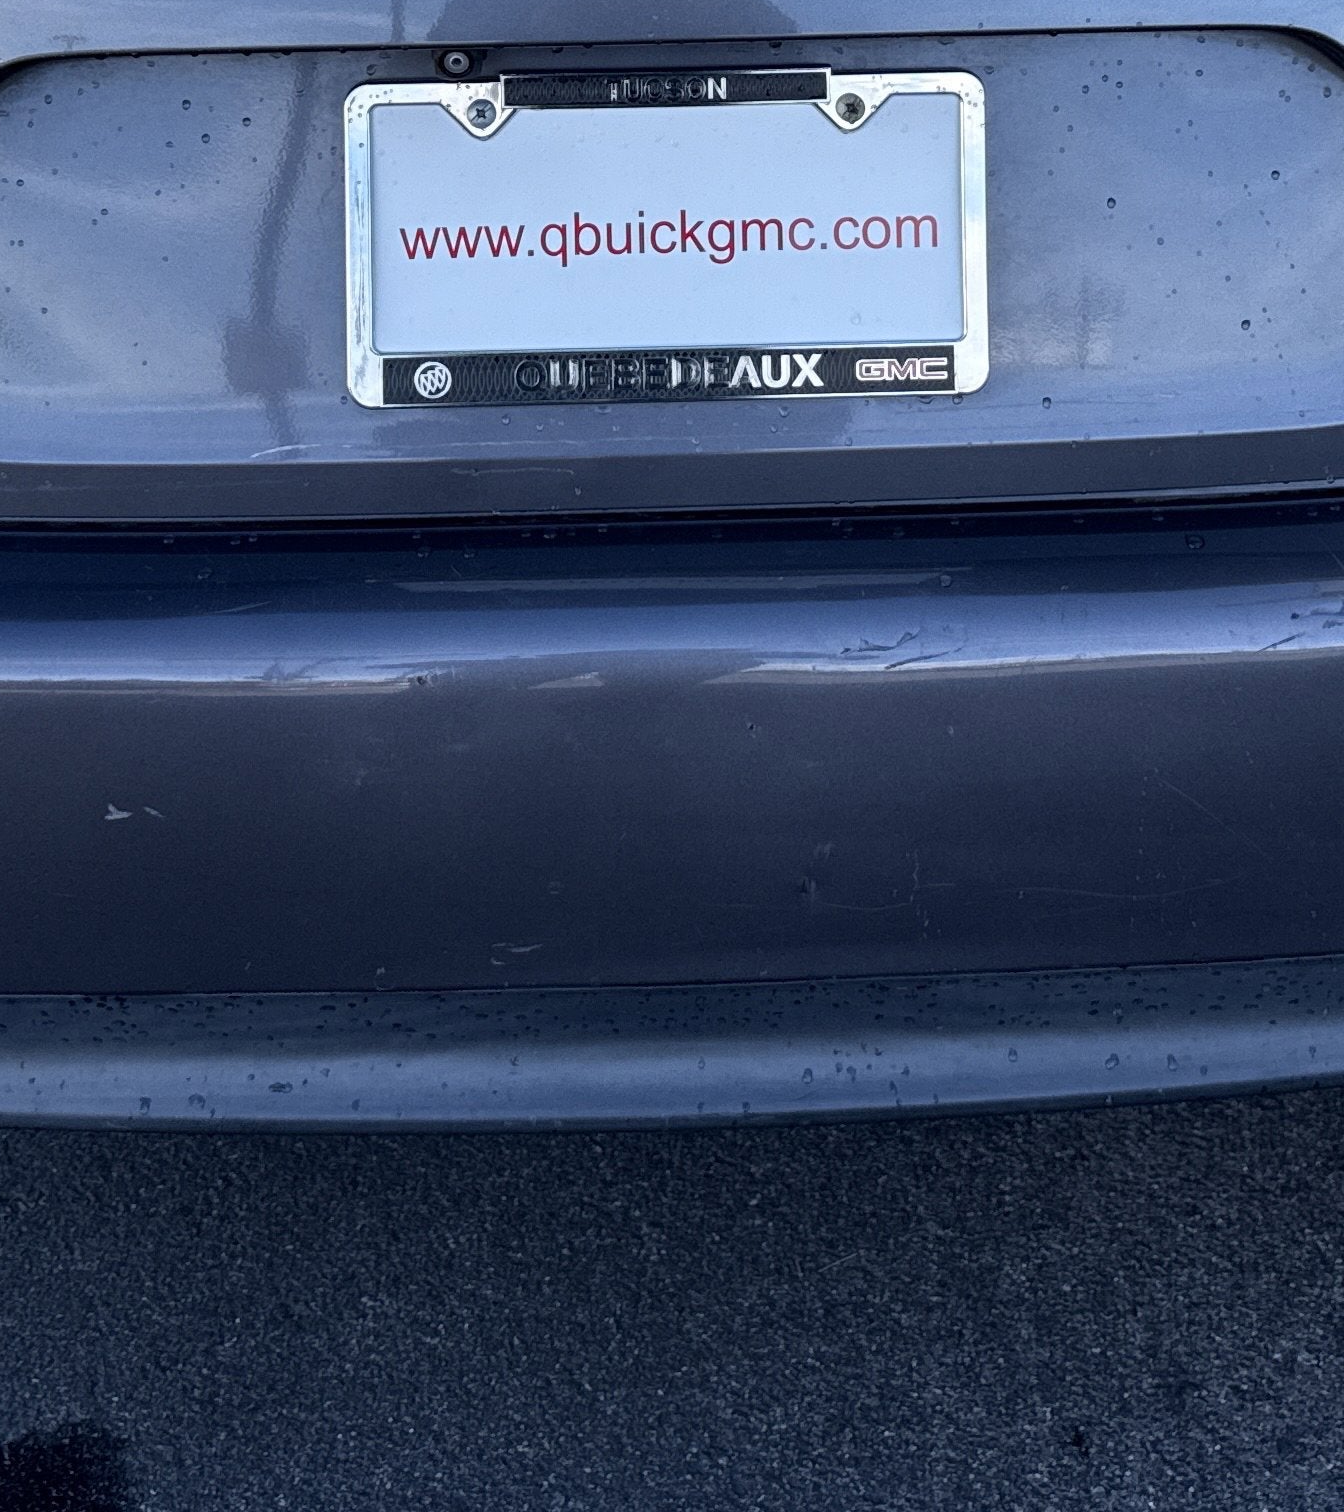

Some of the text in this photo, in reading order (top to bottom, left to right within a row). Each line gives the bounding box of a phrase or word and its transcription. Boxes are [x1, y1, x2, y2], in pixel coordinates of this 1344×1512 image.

[602, 76, 728, 105] TUCSON
[399, 208, 939, 268] www.qbuickgmc.com
[855, 356, 949, 382] GMC
